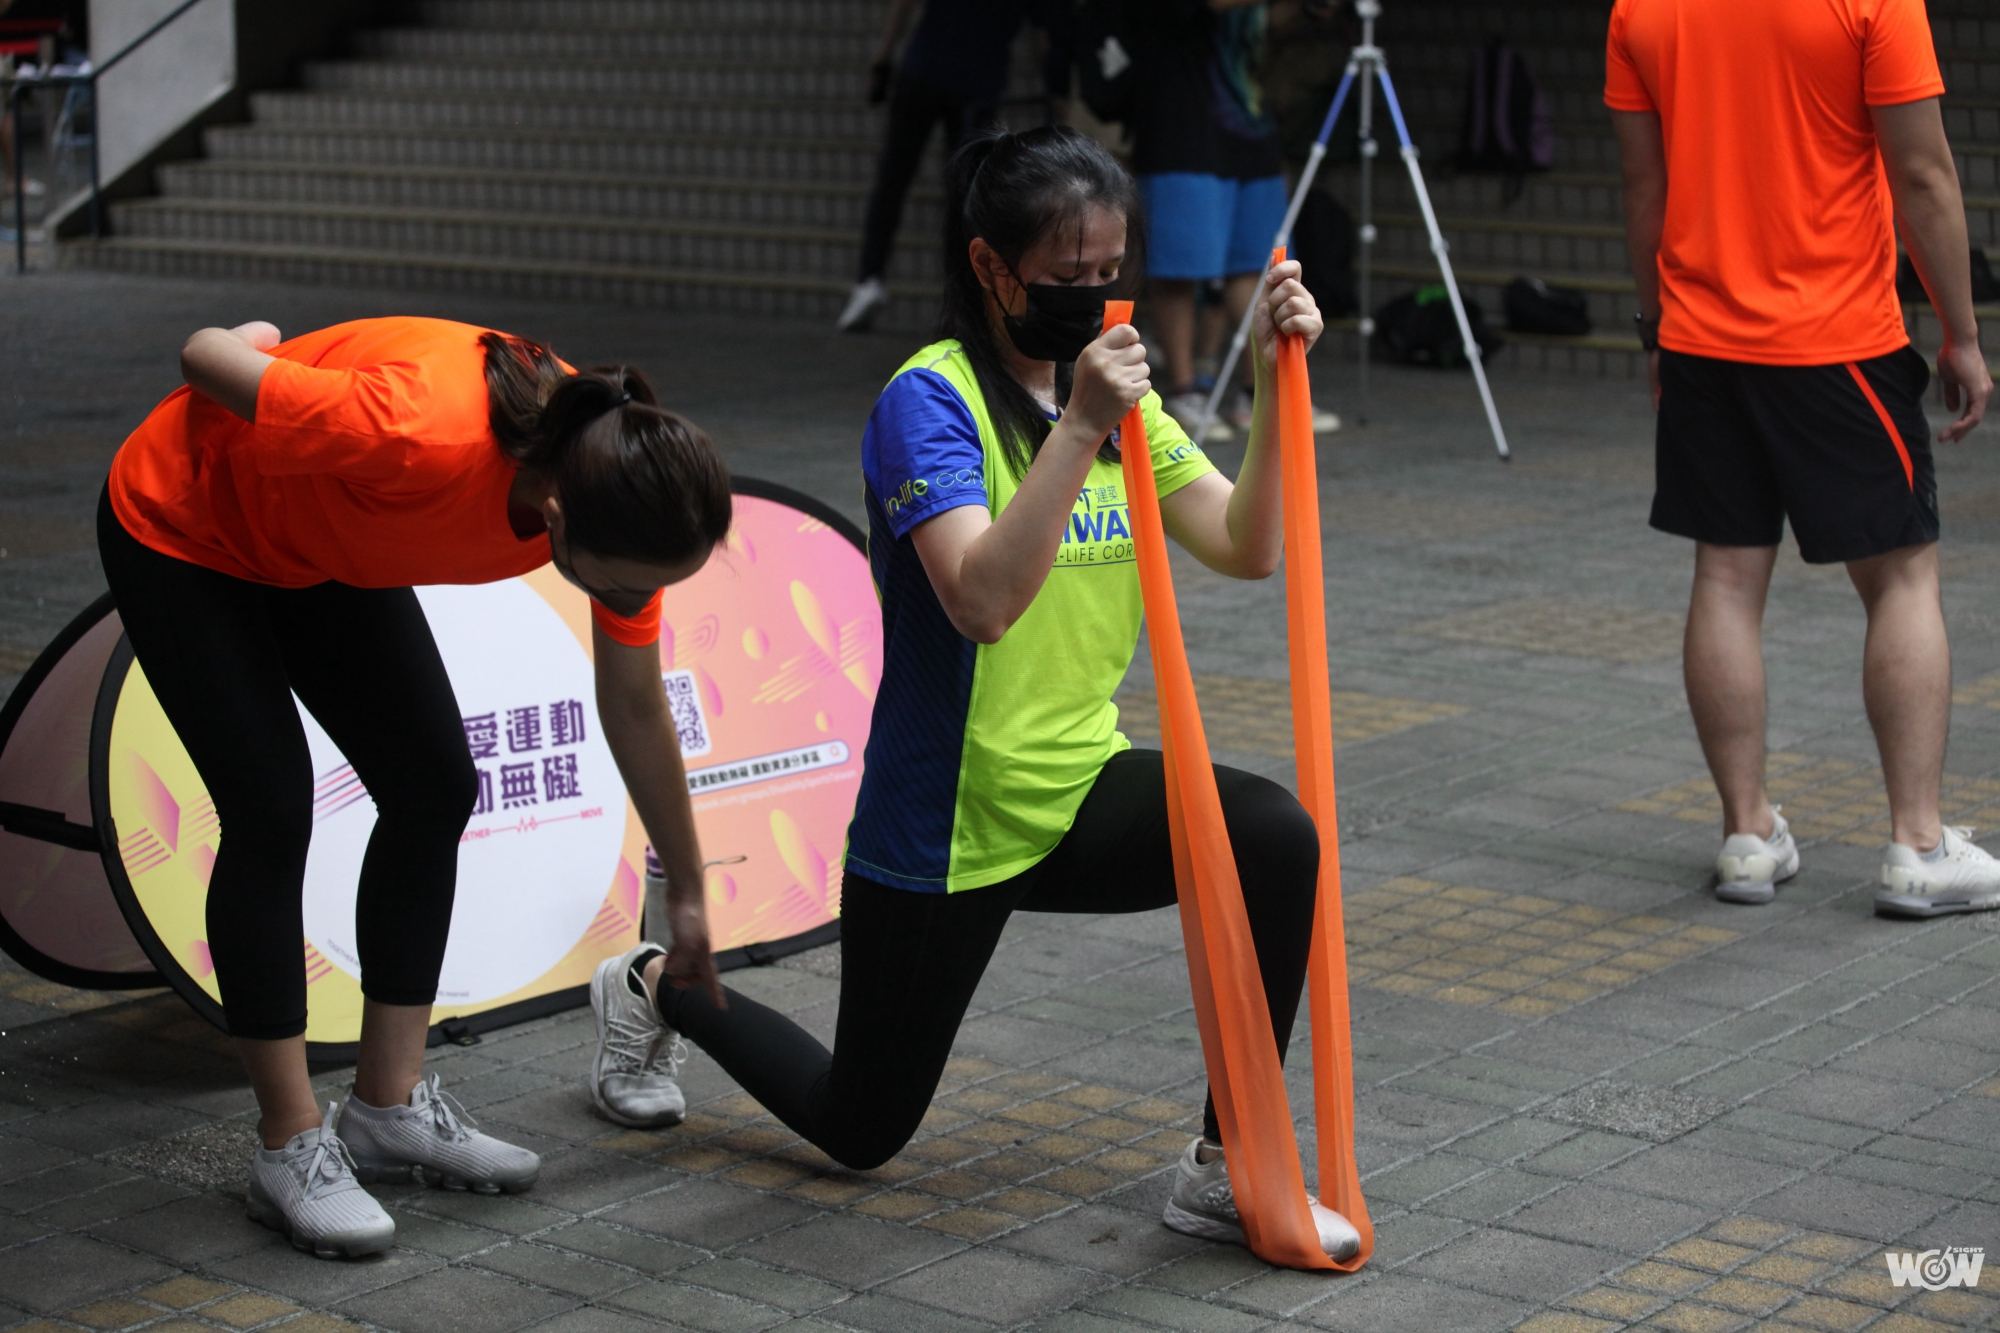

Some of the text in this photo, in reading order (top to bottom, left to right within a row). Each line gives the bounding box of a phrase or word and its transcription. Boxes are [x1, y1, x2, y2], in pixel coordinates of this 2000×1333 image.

[884, 479, 929, 518] in-life
[1054, 543, 1135, 563] -LIFE COR
[462, 699, 586, 760] 愛運動
